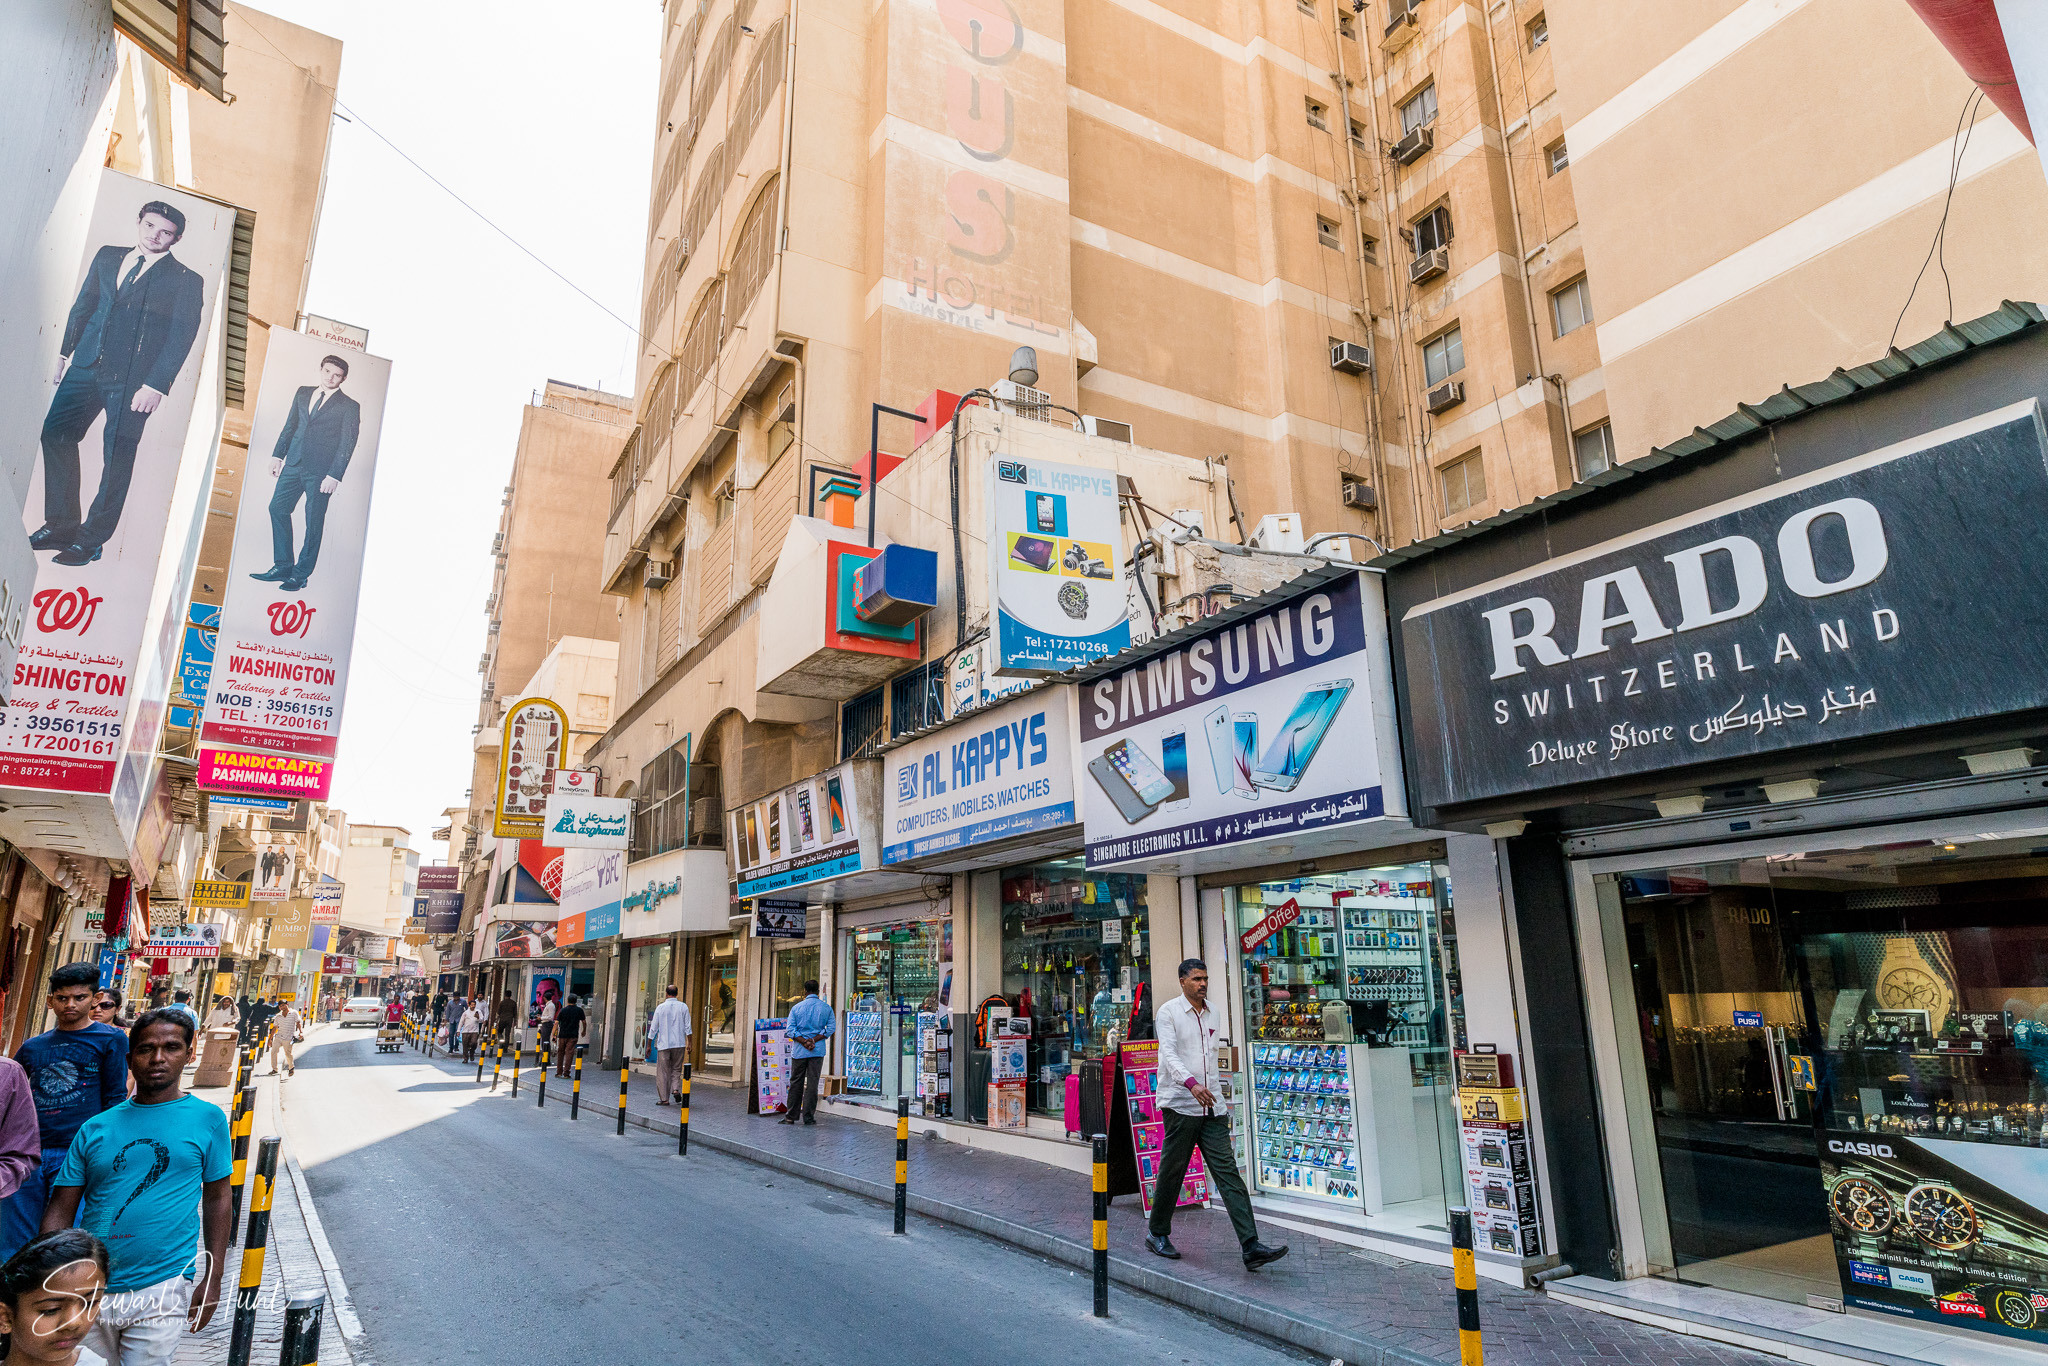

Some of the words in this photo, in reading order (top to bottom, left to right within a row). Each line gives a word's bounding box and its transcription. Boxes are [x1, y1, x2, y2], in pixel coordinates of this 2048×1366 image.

[906, 258, 1060, 338] HOTEL
[309, 328, 321, 337] AL
[325, 332, 364, 348] FARDAN
[1028, 468, 1047, 487] AL
[1051, 472, 1112, 497] KAPPYS
[1481, 497, 1889, 680] RADO
[1025, 636, 1040, 648] Tel
[1050, 638, 1109, 654] 17210268
[229, 655, 336, 686] WASHINGTON
[1093, 592, 1336, 731] SAMSUNG
[1494, 607, 1901, 726] SWITZERLAND
[13, 663, 127, 697] SHINGTON
[190, 679, 208, 690] Ca
[226, 679, 275, 698] Tailoring
[280, 686, 289, 696] &
[292, 688, 331, 702] Textiles
[46, 698, 60, 710] &
[66, 700, 118, 718] Textiles
[216, 692, 252, 708] MOB
[266, 698, 334, 718] 39561515
[1817, 684, 1878, 725] متجر
[26, 715, 122, 738] 39561515
[220, 708, 248, 722] TEL
[263, 712, 328, 731] 17200161
[1689, 695, 1808, 744] ديلوكس
[22, 733, 114, 756] 17200161
[263, 738, 284, 748] 88724
[1527, 734, 1598, 768] Deluxe
[1609, 721, 1675, 761] Store
[214, 752, 324, 774] HANDICRAFTS
[508, 713, 527, 805] ARADOUS
[922, 750, 946, 800] AL
[952, 711, 1048, 791] KAPPYS
[20, 766, 50, 777] 88724
[212, 767, 277, 785] PASHMINA
[280, 774, 320, 789] SHAWL
[558, 786, 590, 794] MoneyGram
[896, 806, 950, 834] COMPUTERS,
[992, 819, 1010, 832] احمد
[1011, 817, 1032, 828] يوسف
[1093, 841, 1130, 862] SINGAPORE
[1132, 832, 1180, 854] ELECTRONICS
[1184, 826, 1208, 846] W.L.L.
[605, 852, 620, 886] BFC
[194, 890, 234, 898] UNION
[195, 884, 235, 892] STERN
[84, 918, 106, 930] re
[86, 912, 105, 920] him
[1244, 922, 1269, 949] Special
[1268, 904, 1296, 931] Offer
[1728, 906, 1771, 925] RADO
[170, 946, 217, 956] REPAIRING
[1738, 1018, 1759, 1026] PUSH
[1962, 1013, 1998, 1021] G-SHOCK
[1122, 1044, 1152, 1052] SINGAPORE
[1878, 1254, 1902, 1262] Infiniti
[1904, 1256, 1918, 1264] Red
[1920, 1260, 1934, 1268] Bull
[1936, 1262, 1963, 1274] Racing
[1965, 1267, 1996, 1278] Limited
[1998, 1272, 2028, 1282] Edition
[1898, 1274, 1924, 1284] CASIO
[1940, 1301, 1984, 1314] TOTAL
